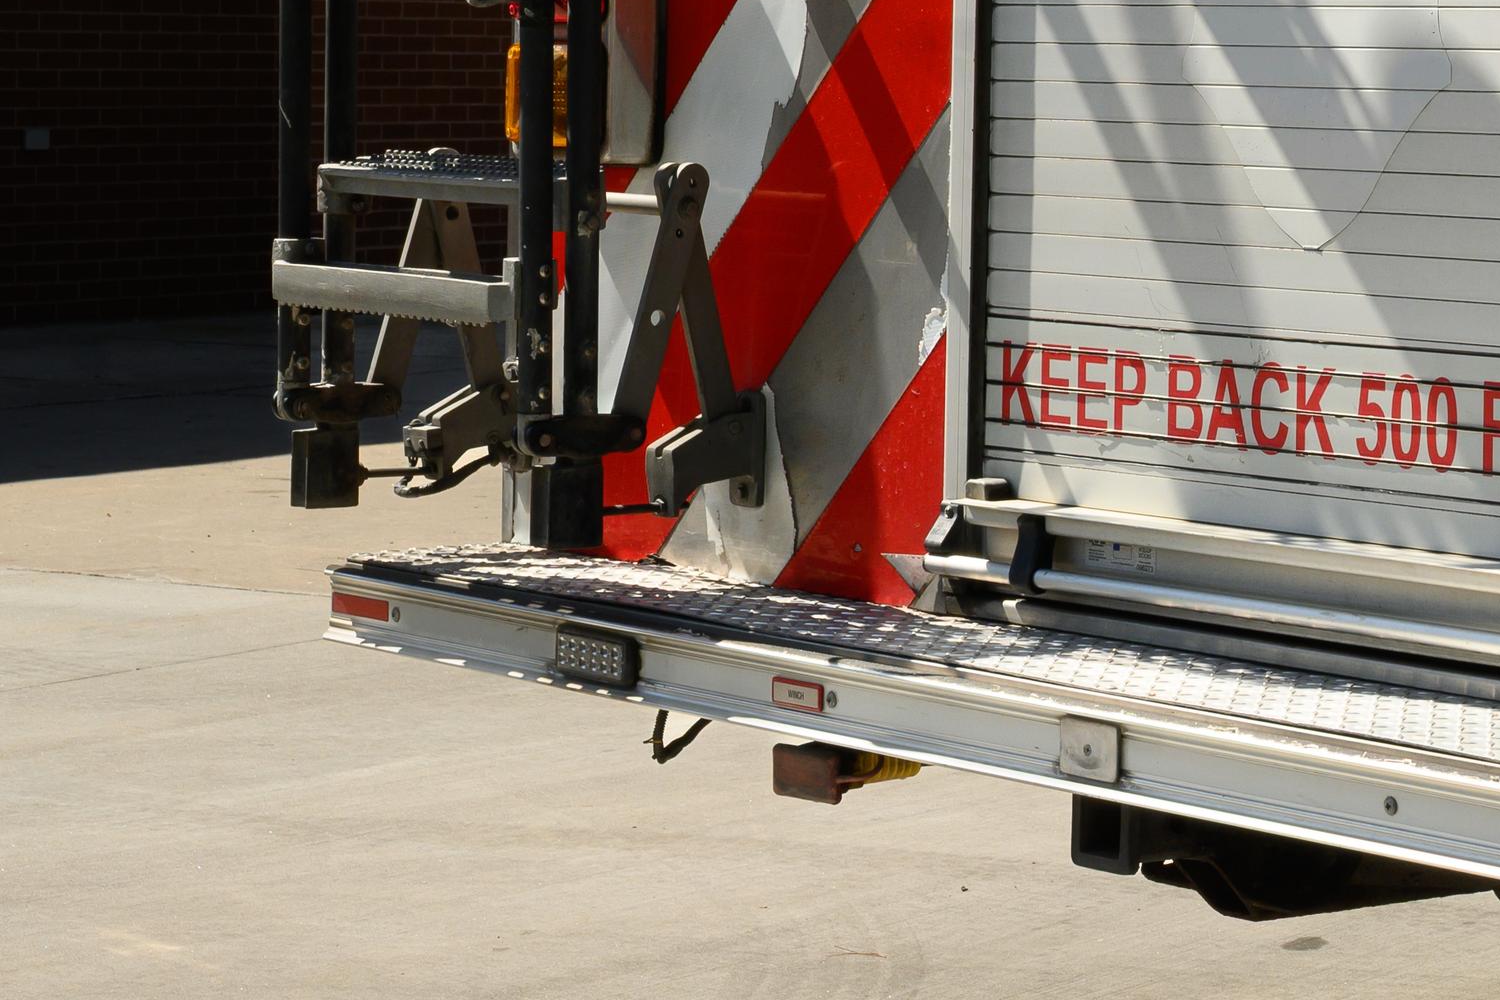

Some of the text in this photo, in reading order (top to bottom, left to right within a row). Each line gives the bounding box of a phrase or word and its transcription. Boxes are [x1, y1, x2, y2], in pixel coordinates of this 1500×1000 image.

[1001, 339, 1147, 436] KEEP
[1167, 354, 1334, 459] BACK
[1356, 371, 1458, 473] 500
